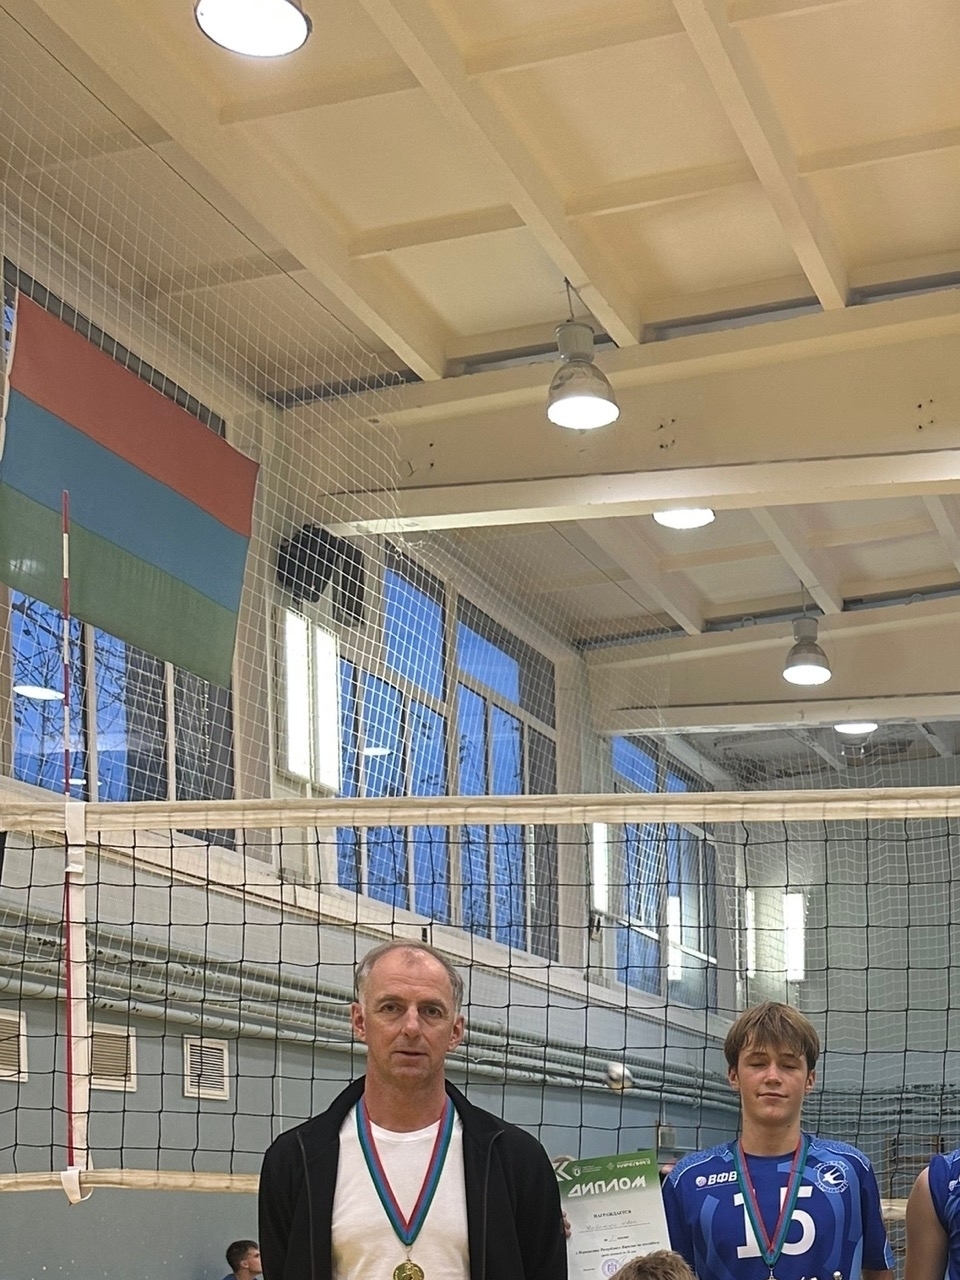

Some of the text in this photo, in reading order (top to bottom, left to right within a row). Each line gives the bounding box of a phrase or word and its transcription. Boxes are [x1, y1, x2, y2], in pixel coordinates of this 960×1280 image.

[568, 1175, 646, 1197] ДИПЛОМ
[707, 1171, 737, 1185] ВФВ
[733, 1186, 816, 1259] 15
